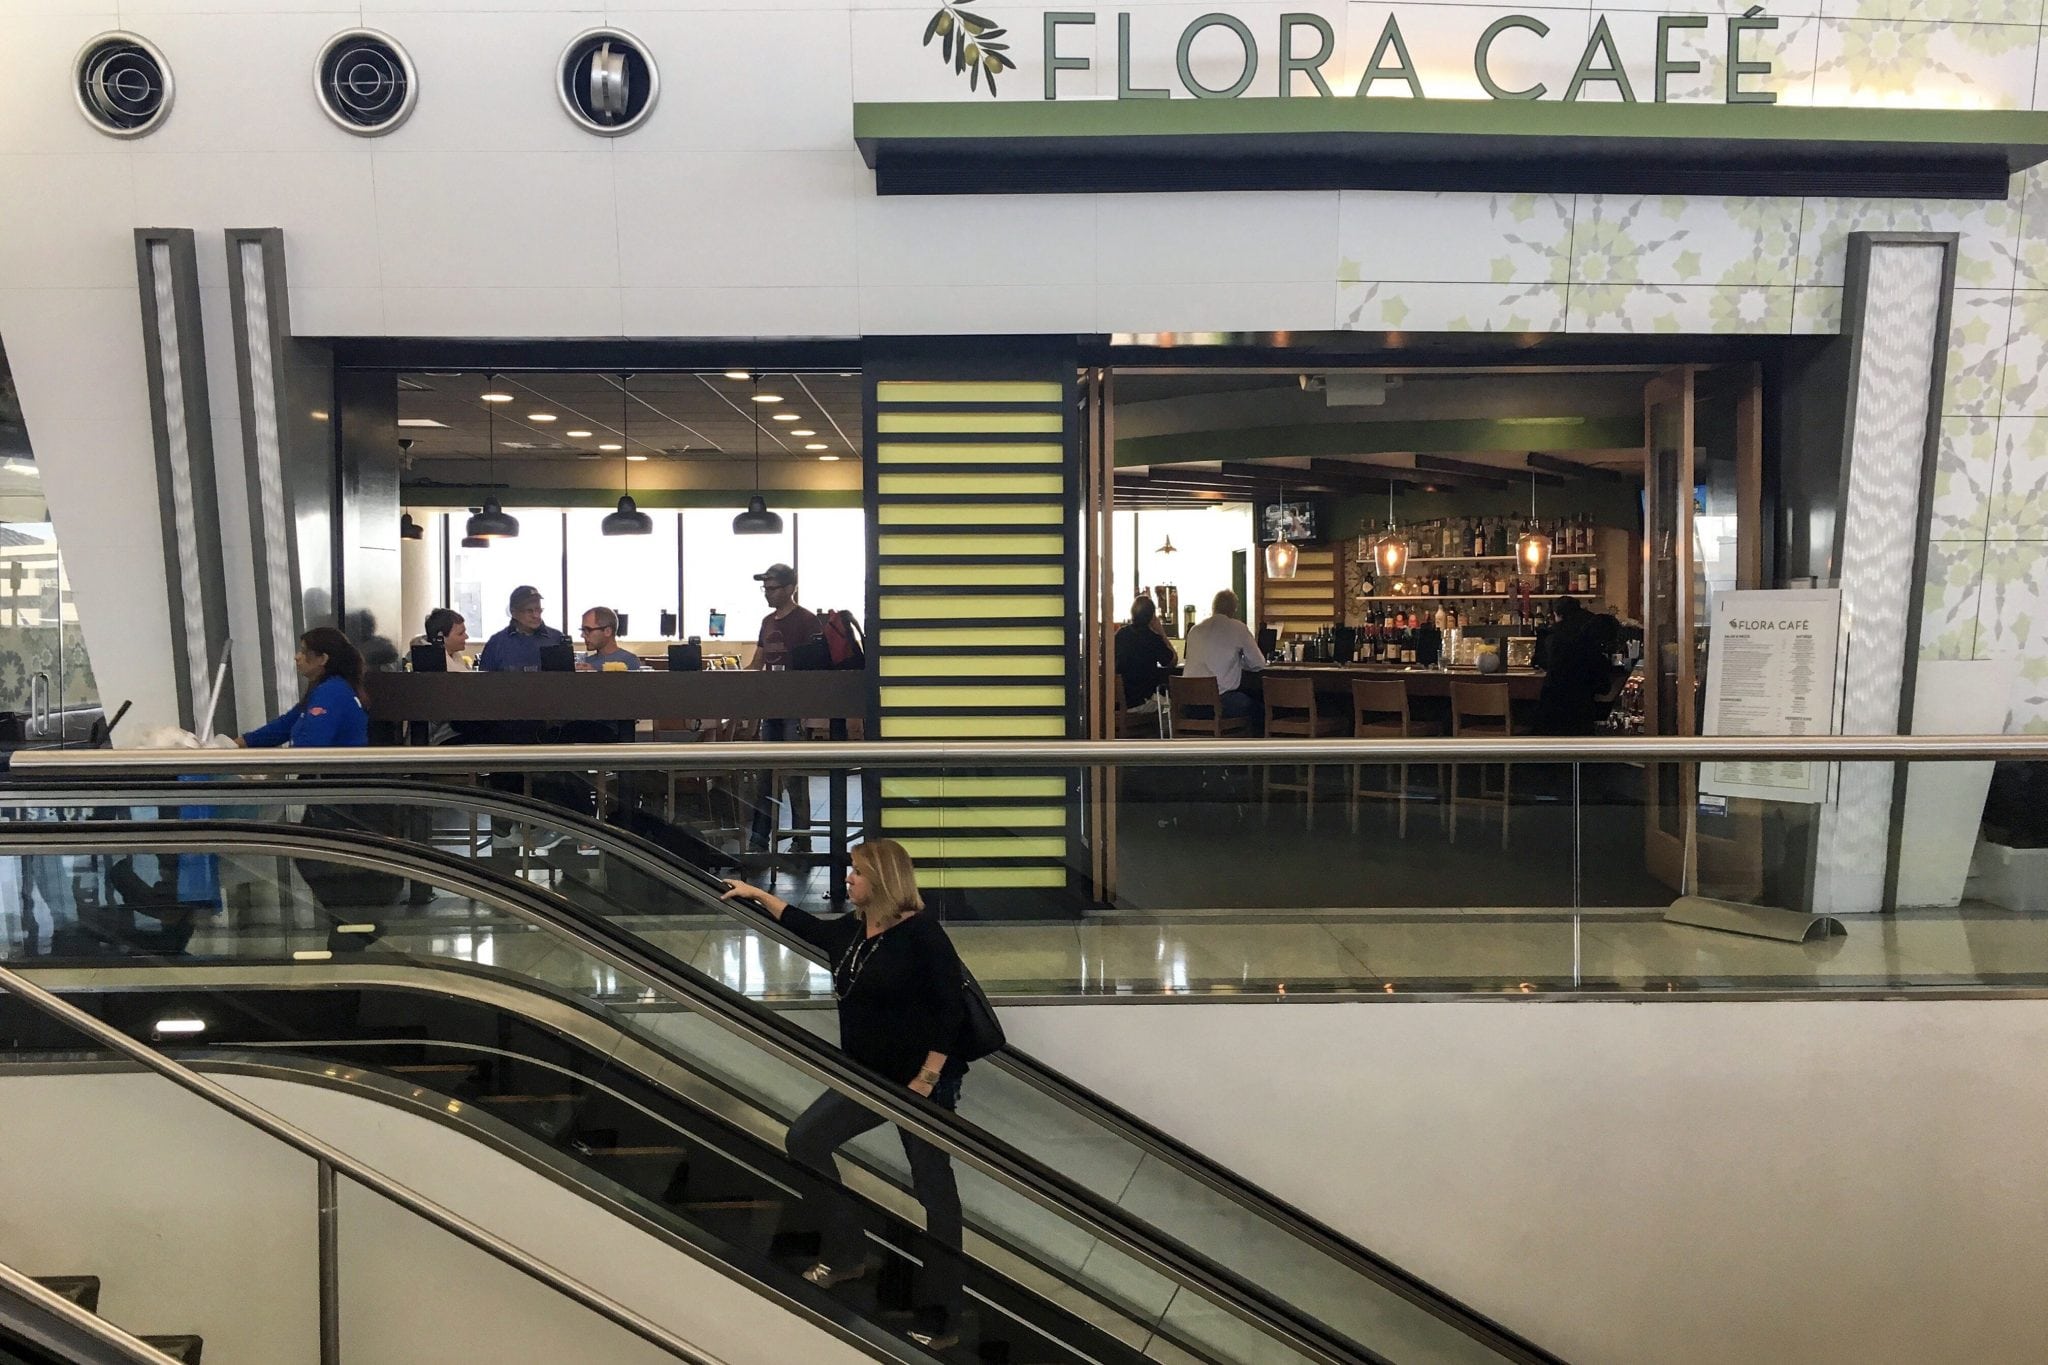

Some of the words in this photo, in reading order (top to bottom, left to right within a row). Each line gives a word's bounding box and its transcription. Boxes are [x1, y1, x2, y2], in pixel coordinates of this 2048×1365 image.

[1044, 12, 1425, 100] FLORA
[1474, 5, 1779, 104] CAFÉ
[1738, 620, 1775, 630] FLORA
[1778, 619, 1809, 630] CAFÉ
